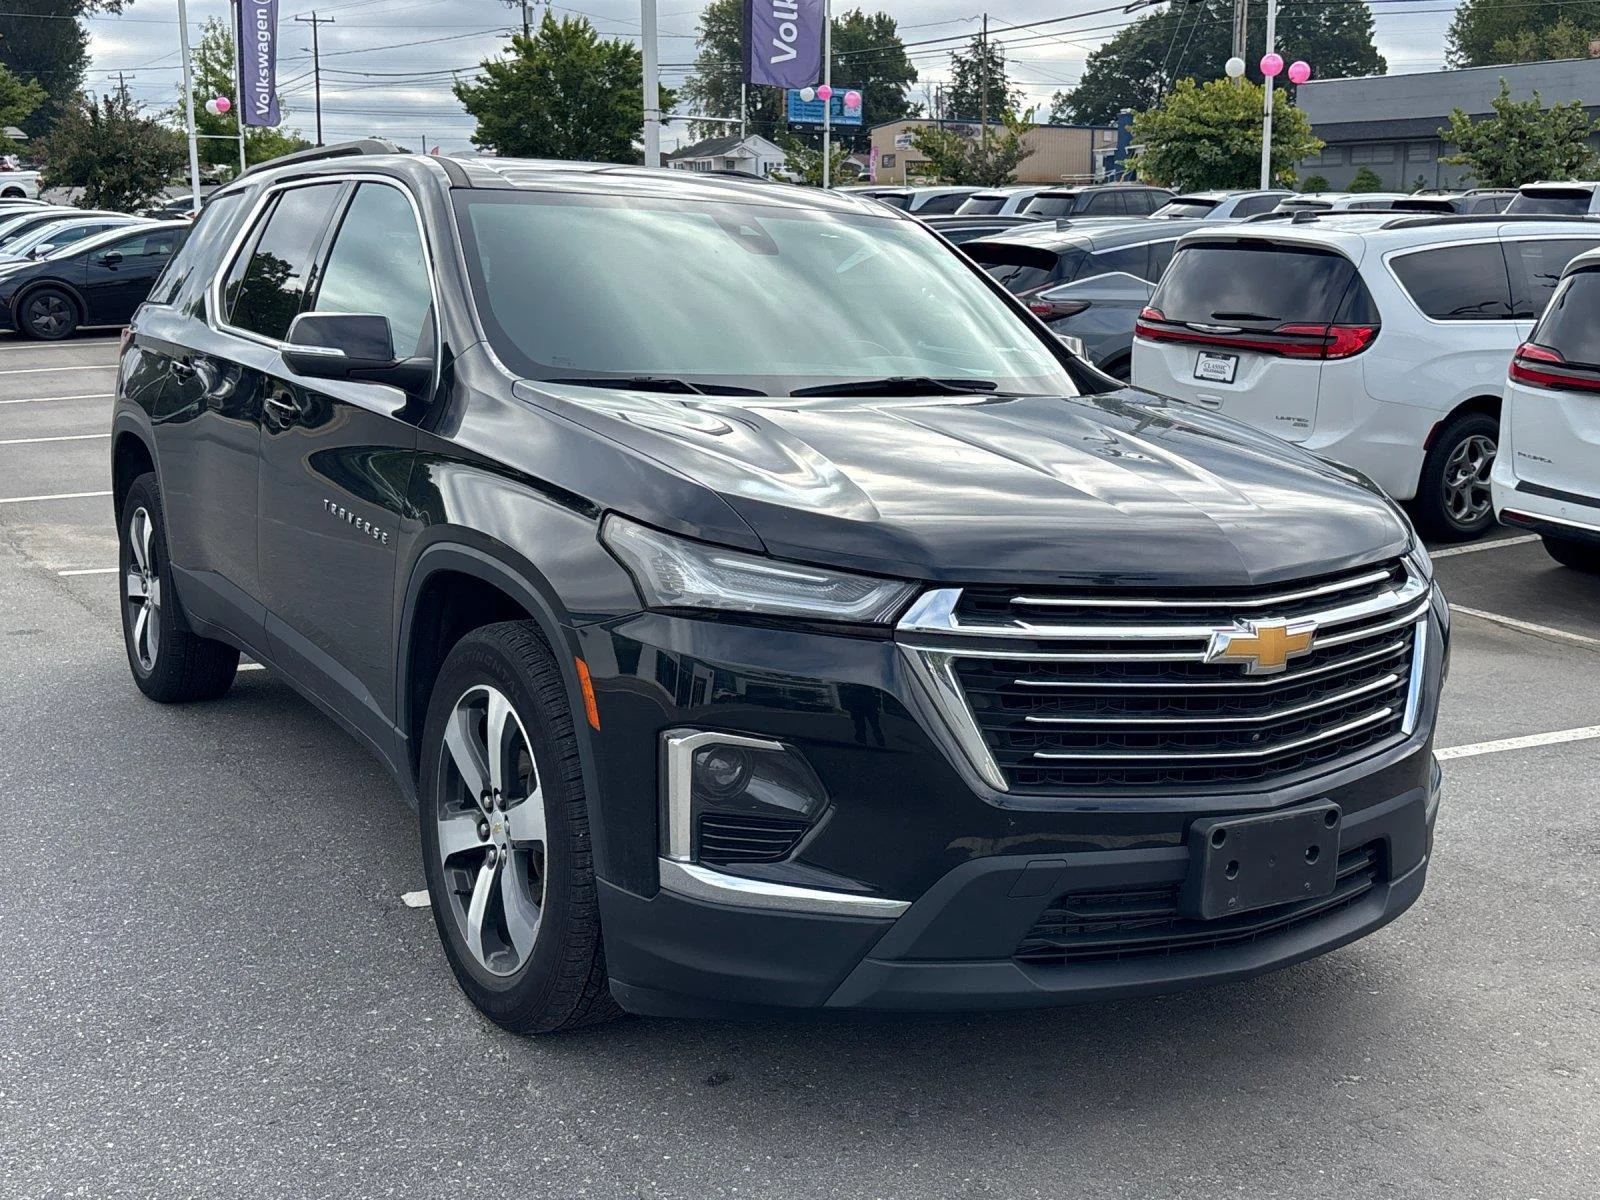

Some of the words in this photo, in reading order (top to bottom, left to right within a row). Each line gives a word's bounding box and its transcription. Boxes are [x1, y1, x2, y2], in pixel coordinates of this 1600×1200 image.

[256, 8, 271, 115] Volkswagen
[1203, 362, 1227, 371] CLASSIC
[323, 499, 389, 545] TRAVERSE
